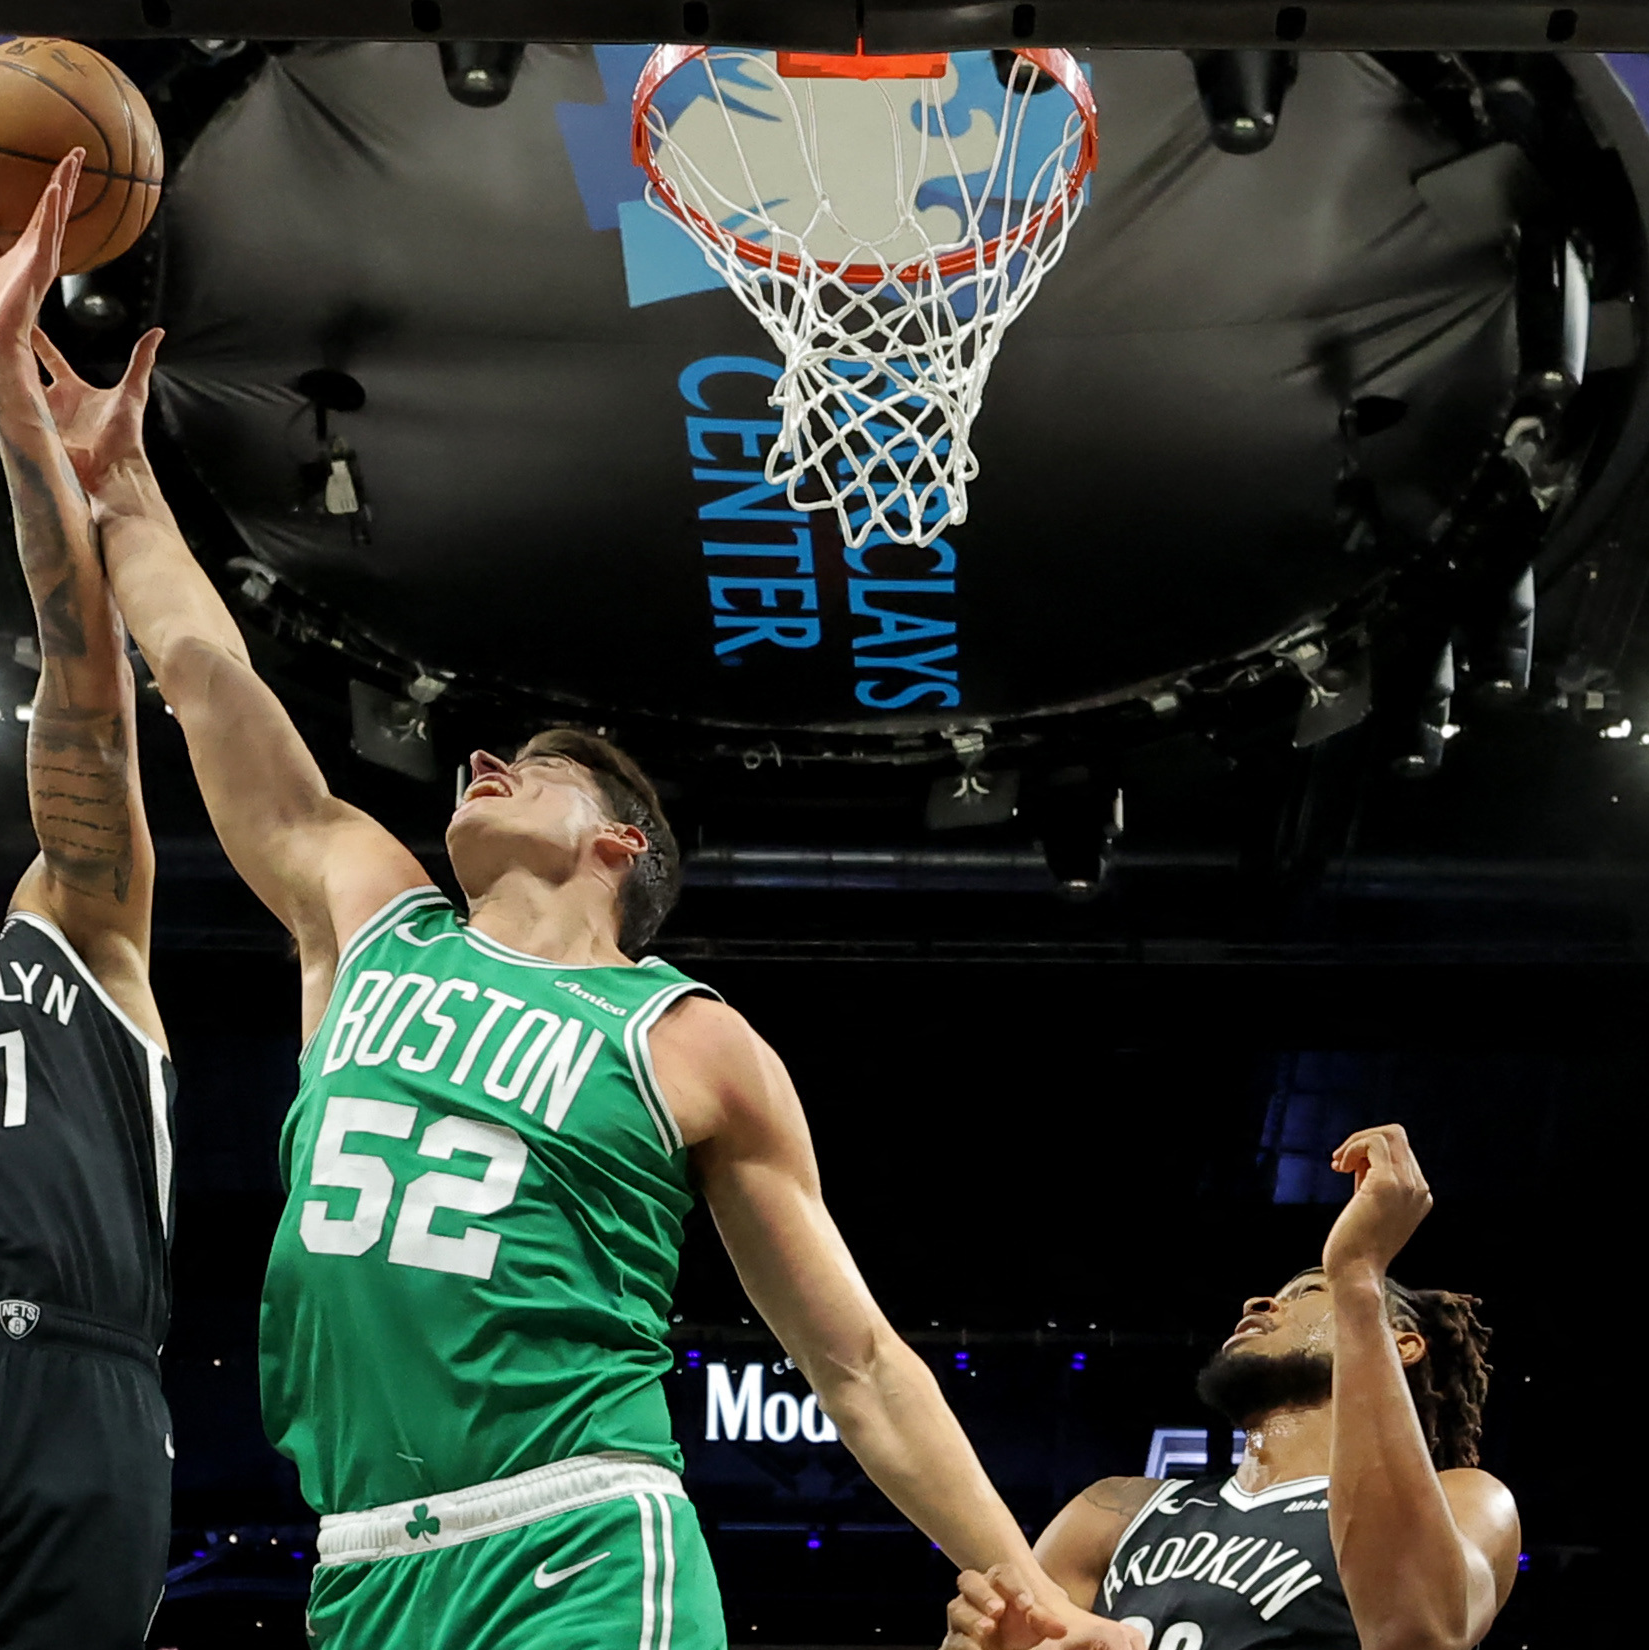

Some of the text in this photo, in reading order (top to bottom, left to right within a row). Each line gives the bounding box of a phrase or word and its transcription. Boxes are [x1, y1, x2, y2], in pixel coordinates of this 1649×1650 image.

[678, 355, 822, 657] CENTER
[830, 357, 961, 710] BARCLAYS
[320, 969, 606, 1133] BOSTON
[554, 979, 627, 1018] Amica
[298, 1096, 529, 1281] 52
[2, 1303, 36, 1321] NETS
